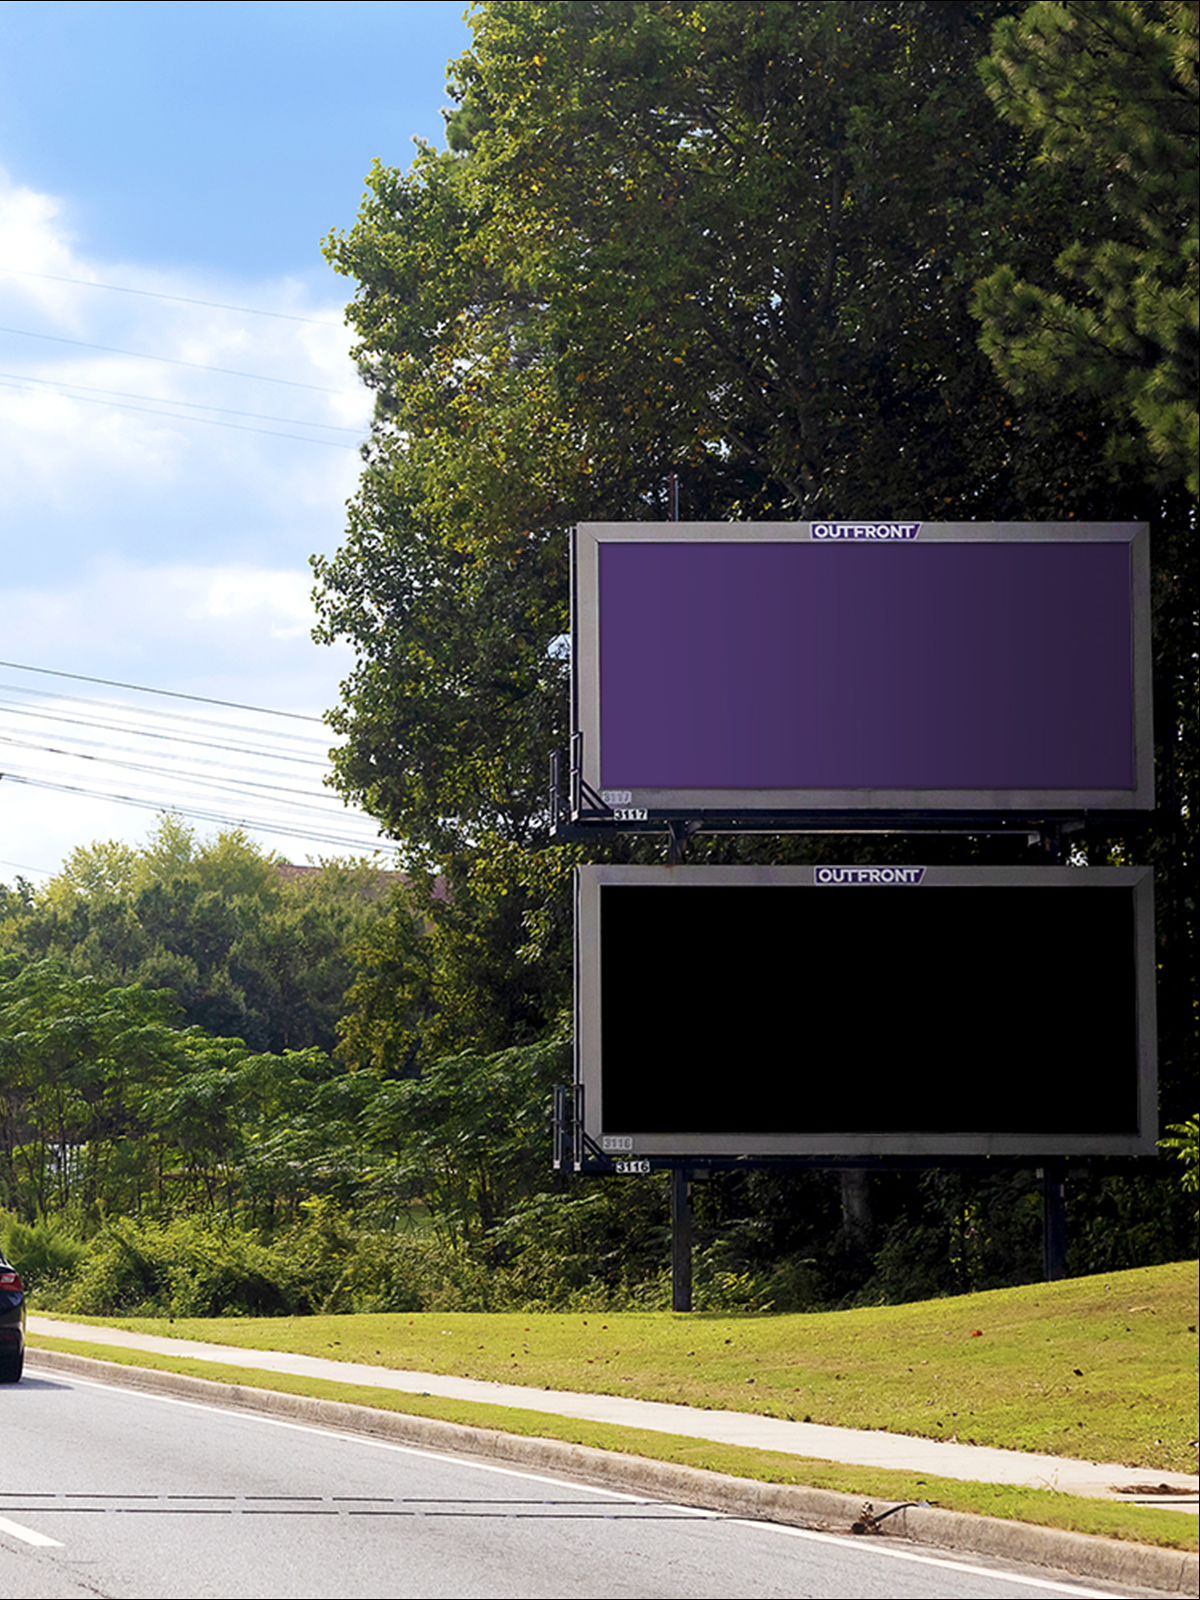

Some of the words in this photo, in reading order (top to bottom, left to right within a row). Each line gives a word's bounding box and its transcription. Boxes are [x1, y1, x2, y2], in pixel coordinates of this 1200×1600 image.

[814, 525, 915, 538] OUTFRONT
[615, 809, 647, 820] 3117
[818, 869, 919, 882] OUTFRONT
[603, 1137, 632, 1149] 3116
[616, 1161, 649, 1172] 3116
